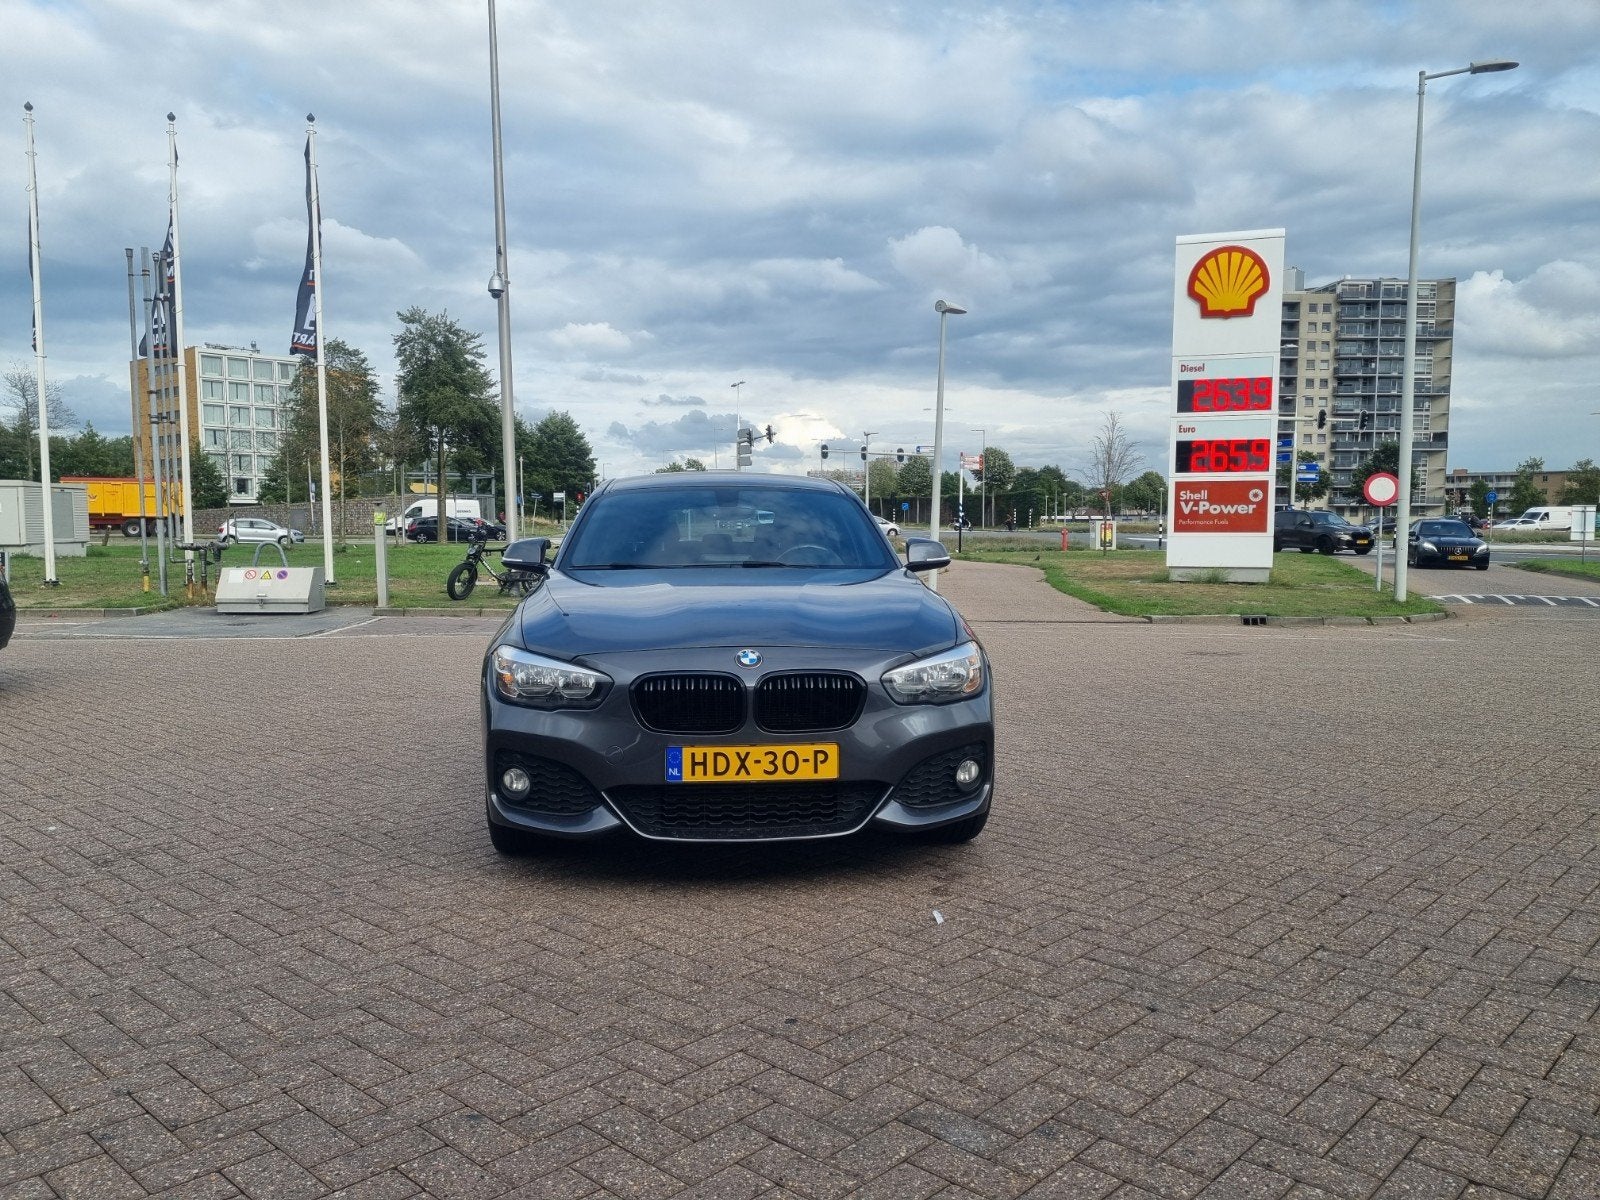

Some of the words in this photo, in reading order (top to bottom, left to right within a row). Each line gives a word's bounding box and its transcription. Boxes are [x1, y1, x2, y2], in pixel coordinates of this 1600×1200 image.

[1180, 363, 1205, 373] Diesel
[1178, 425, 1196, 433] Euro
[1180, 490, 1208, 500] Shell
[1180, 501, 1257, 515] V-Power
[668, 768, 680, 776] NL
[690, 750, 829, 777] HDX-30-P
